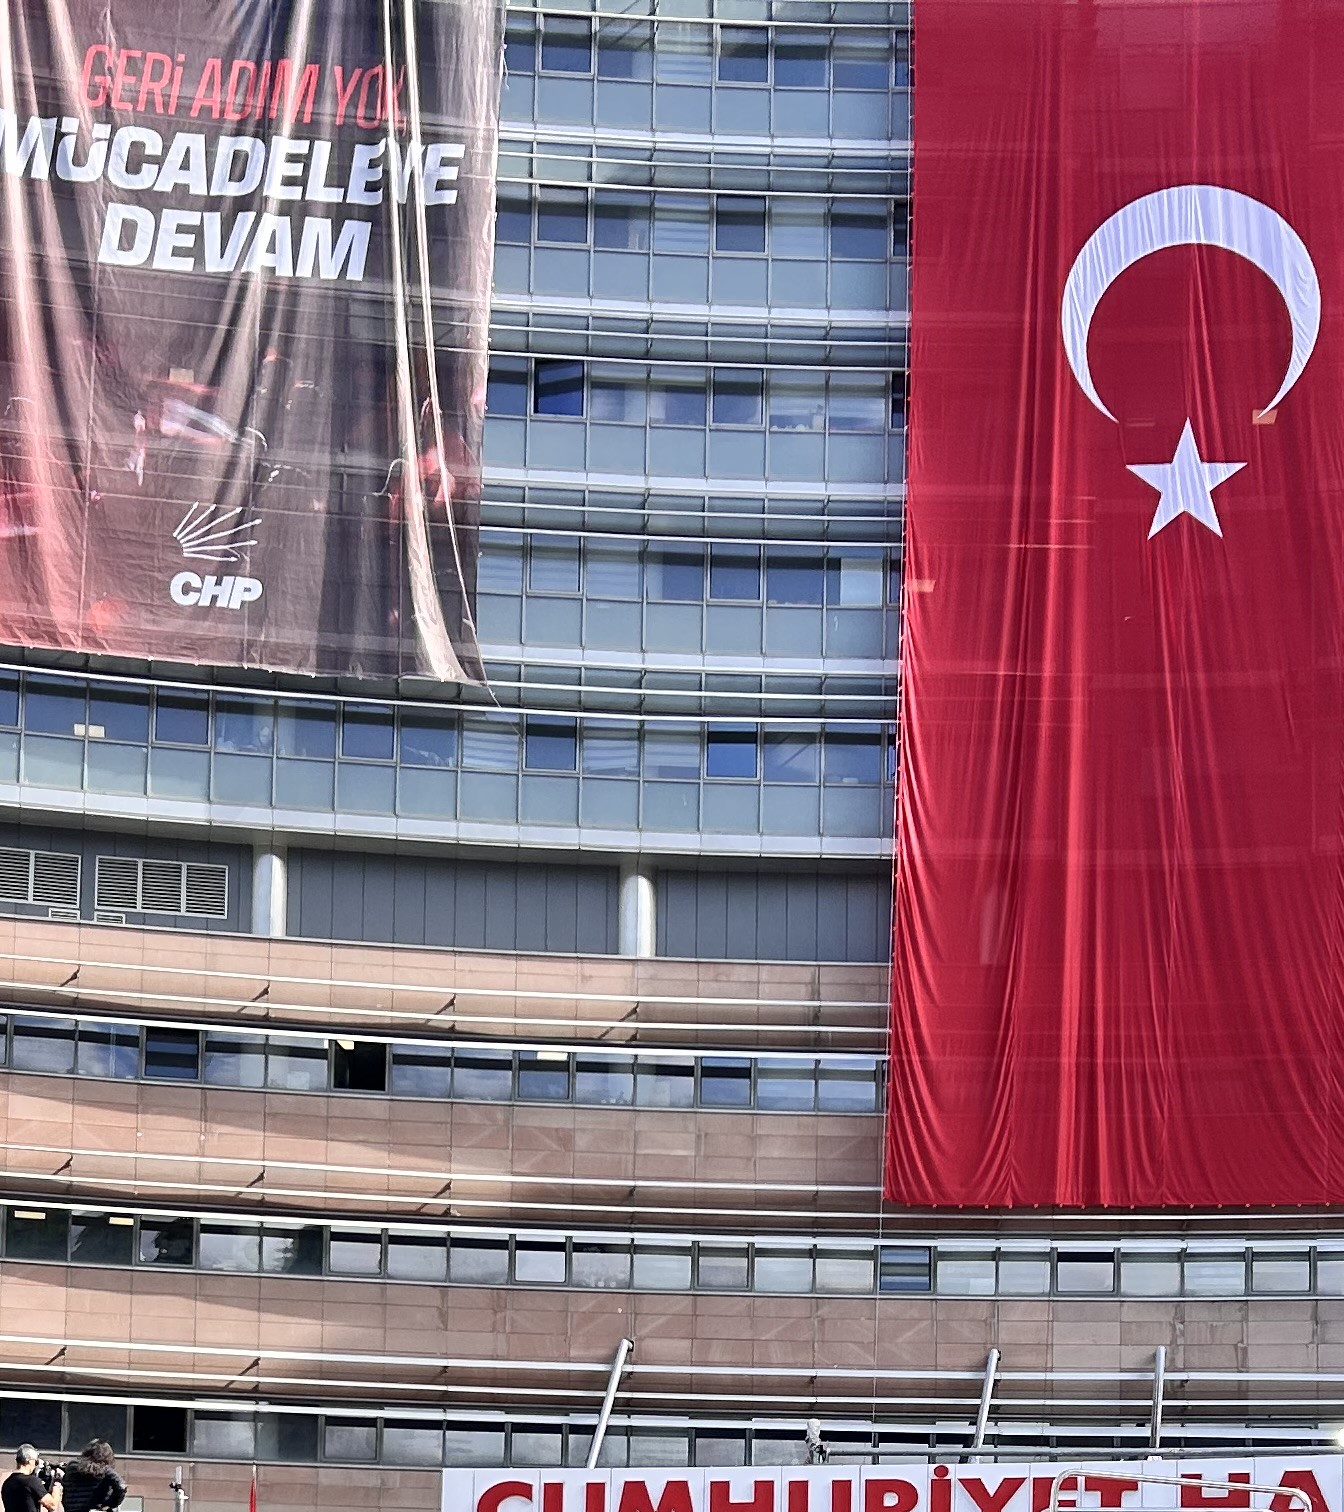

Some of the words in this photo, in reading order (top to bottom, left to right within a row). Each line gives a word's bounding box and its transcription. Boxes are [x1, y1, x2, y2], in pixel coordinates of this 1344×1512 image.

[191, 57, 319, 123] ADIM
[98, 202, 371, 281] DEVAM
[170, 571, 263, 609] CHP
